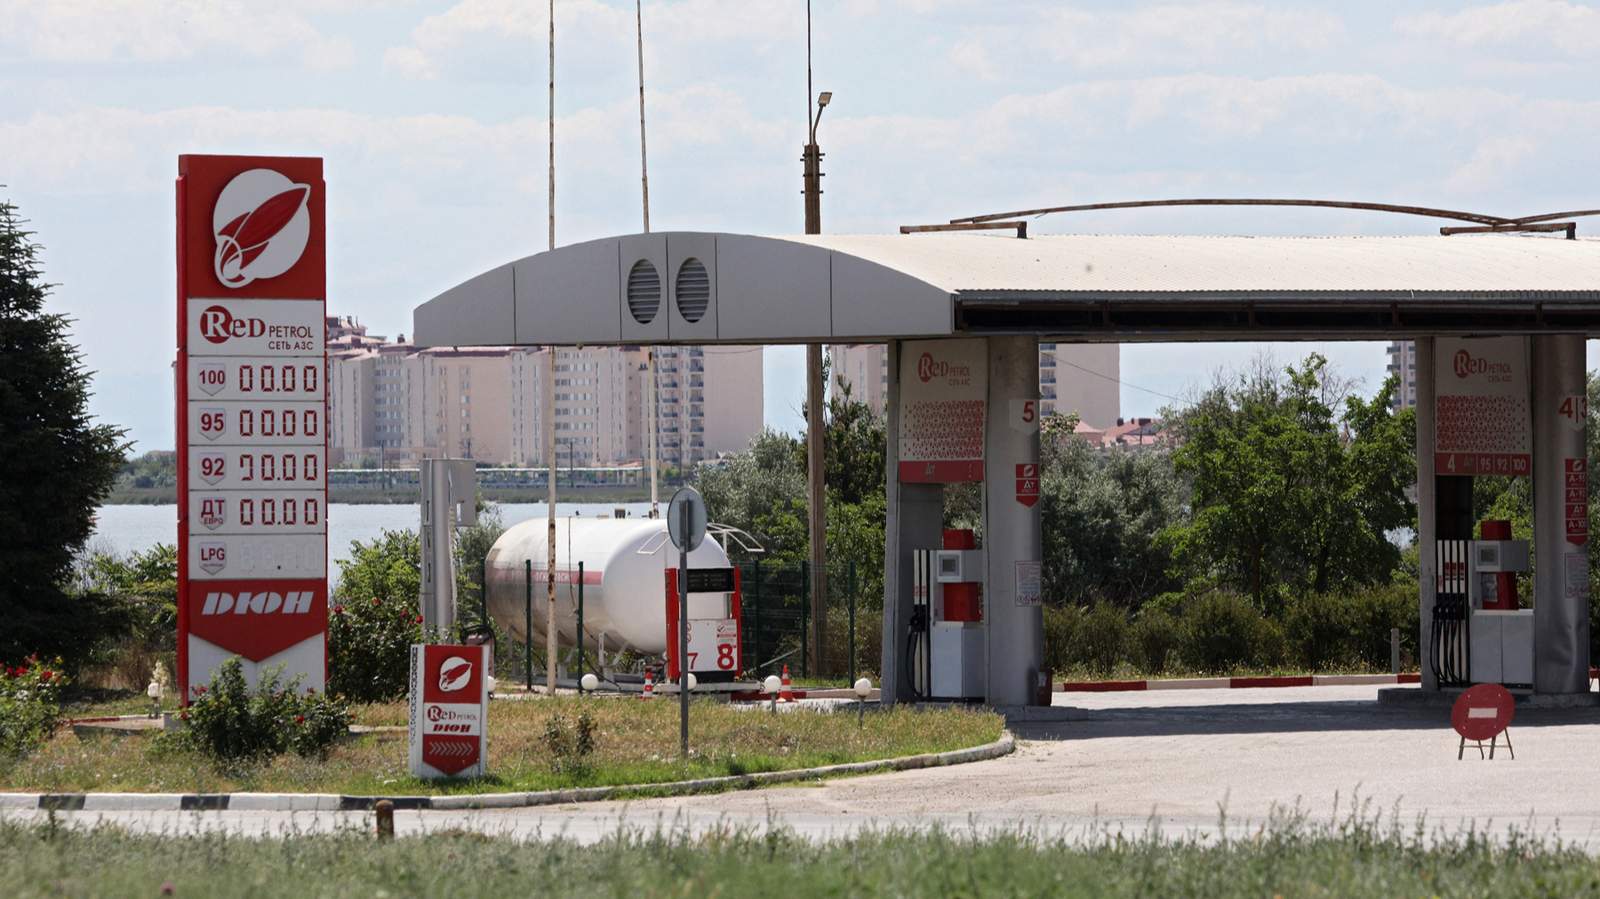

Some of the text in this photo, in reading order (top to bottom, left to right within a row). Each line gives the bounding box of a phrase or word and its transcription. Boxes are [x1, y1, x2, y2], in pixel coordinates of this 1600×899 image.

[269, 326, 313, 338] PETROL
[268, 341, 313, 350] СЕТЬ АЗС
[199, 365, 317, 392] 100 00.00
[1022, 401, 1034, 423] 5
[201, 410, 317, 436] 95 00.00
[202, 458, 224, 476] 92
[1447, 454, 1456, 473] 4
[200, 499, 317, 525] ДТ 00.00
[201, 548, 225, 561] LPG
[687, 643, 734, 670] 7 8
